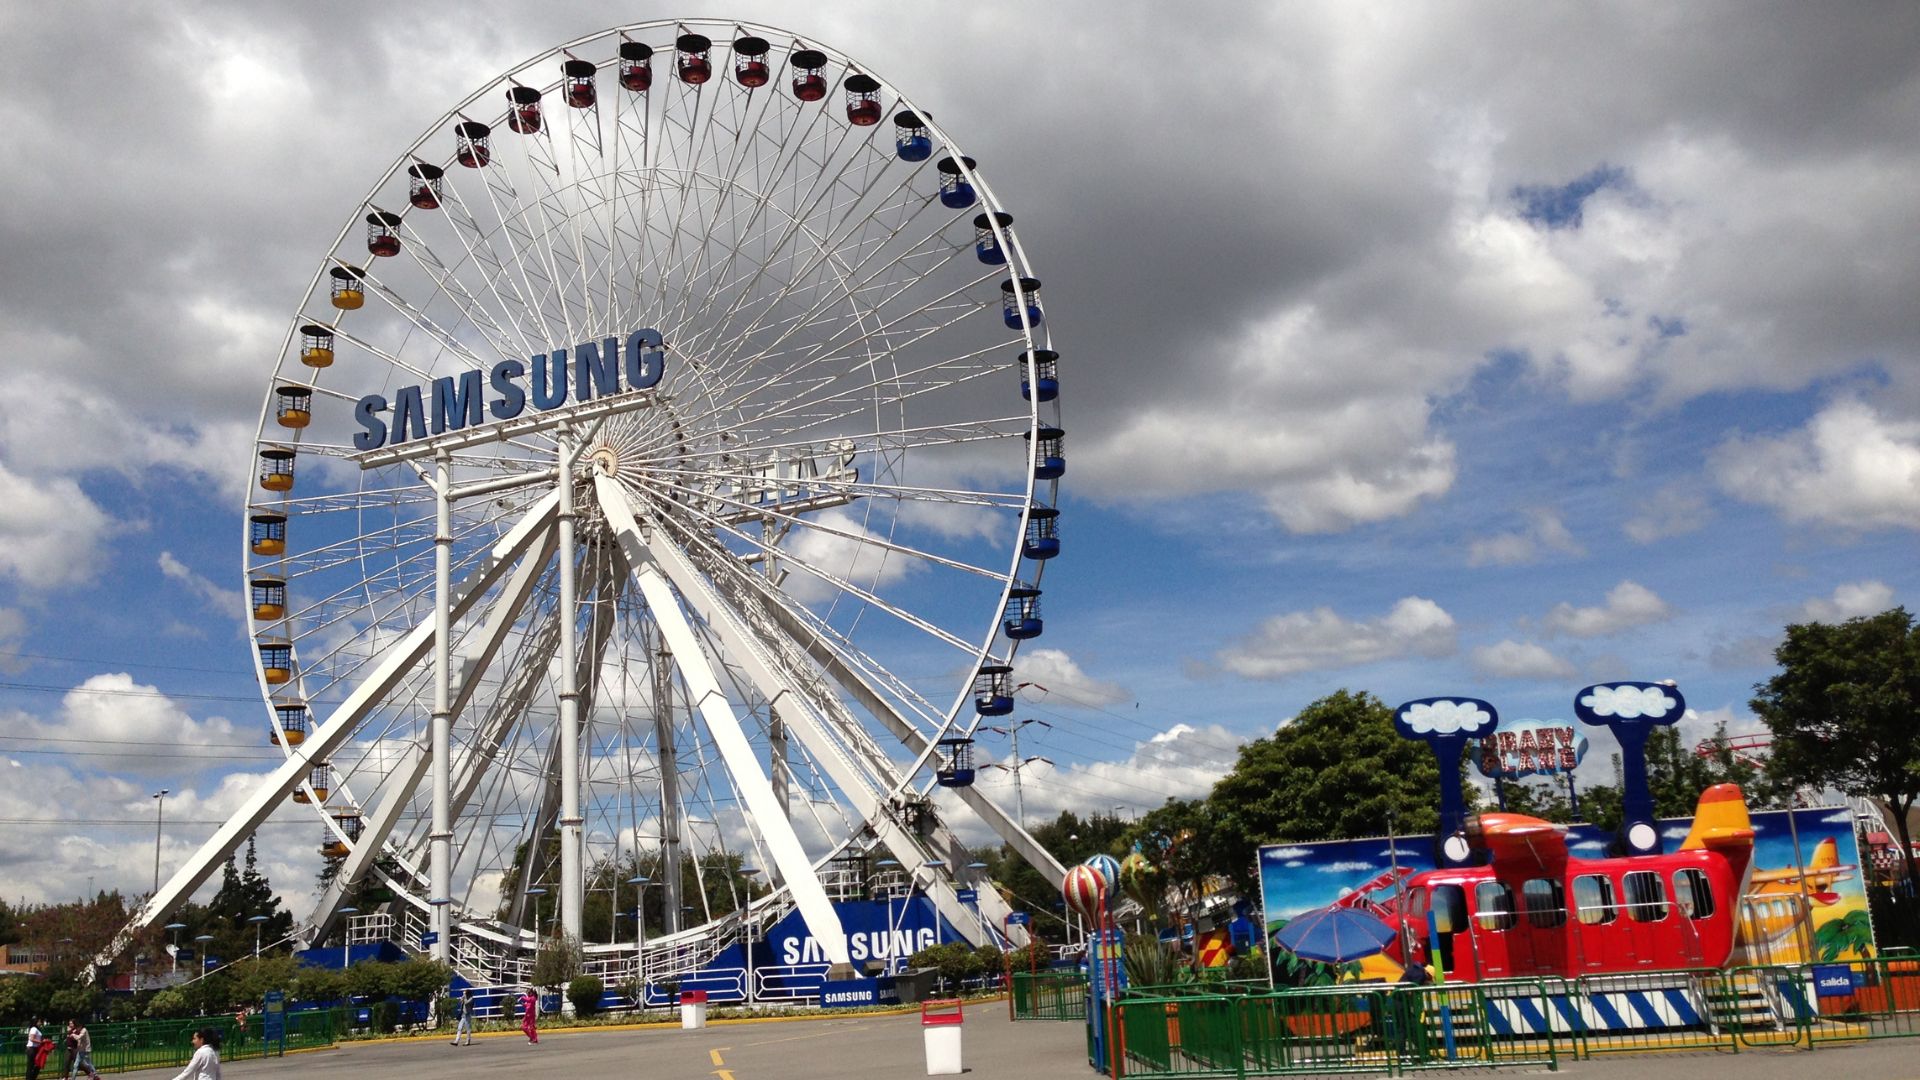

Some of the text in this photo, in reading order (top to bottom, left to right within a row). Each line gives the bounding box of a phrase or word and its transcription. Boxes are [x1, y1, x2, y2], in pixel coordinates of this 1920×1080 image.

[353, 328, 664, 451] SAMSUNG
[783, 928, 935, 965] SASUNG
[1820, 978, 1849, 987] salida
[825, 991, 872, 1003] SAMSUNG
